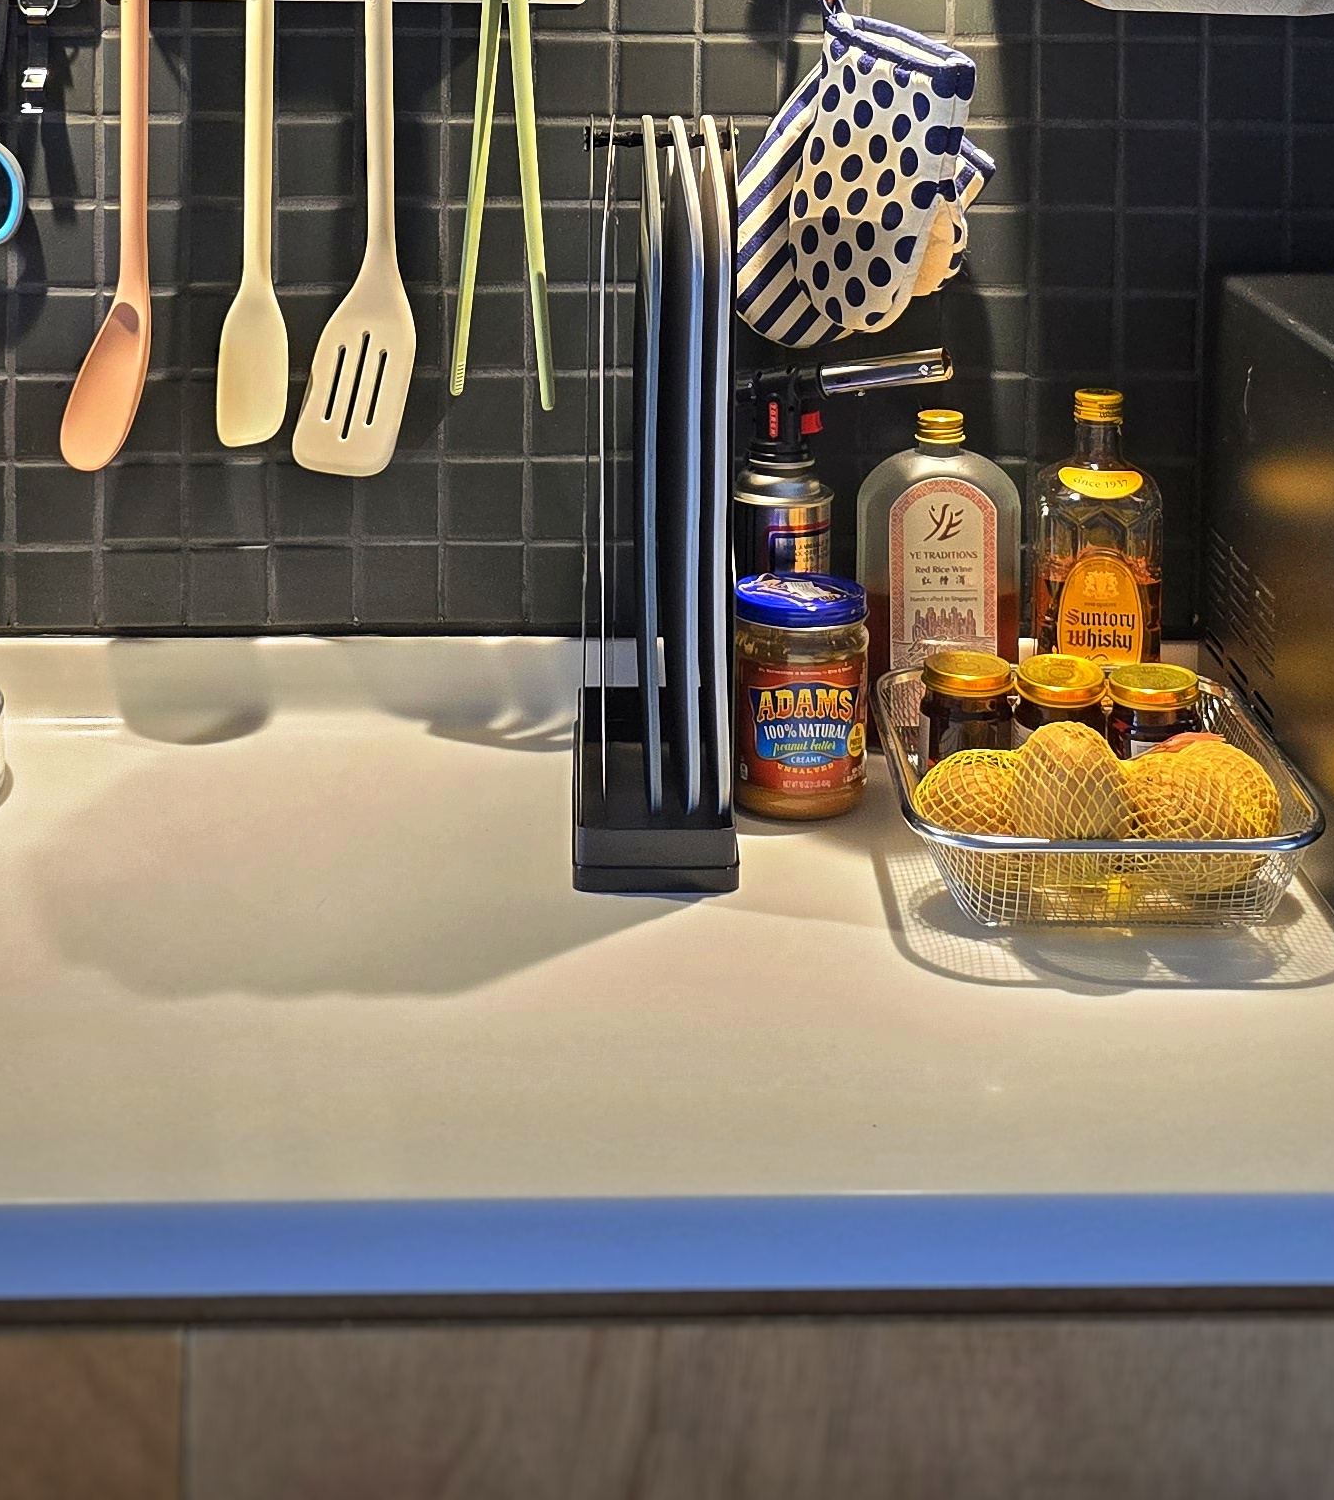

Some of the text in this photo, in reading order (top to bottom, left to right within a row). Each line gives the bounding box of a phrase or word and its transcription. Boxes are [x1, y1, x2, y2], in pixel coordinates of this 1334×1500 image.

[1072, 476, 1101, 489] since
[909, 551, 978, 560] YE TRADITIONS
[915, 565, 973, 574] Red Rice Wine
[1065, 608, 1136, 631] Suntory
[1065, 627, 1133, 654] Whisky
[756, 688, 854, 723] ADAMS
[763, 723, 797, 740] 100%
[798, 723, 846, 740] NATURAL
[772, 739, 836, 757] peanut butter
[790, 755, 822, 764] CREAMY
[777, 762, 834, 774] UNSALTED
